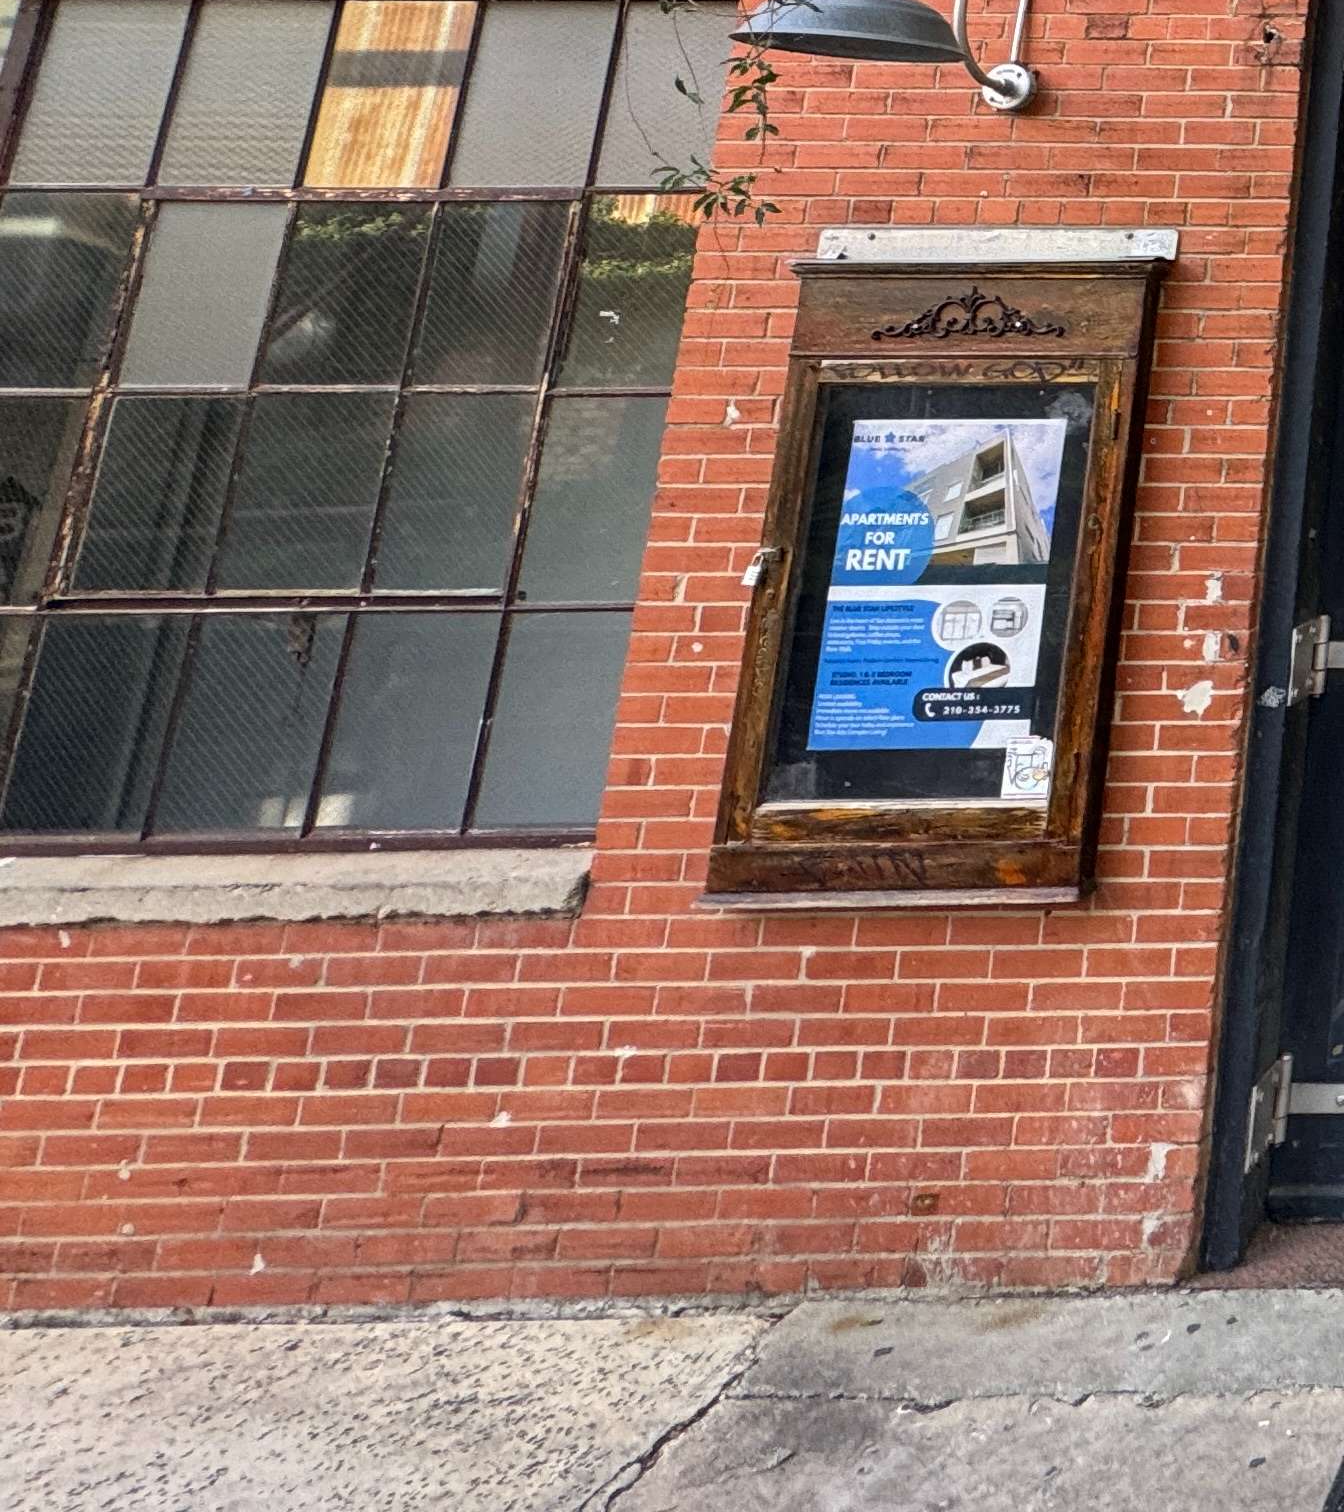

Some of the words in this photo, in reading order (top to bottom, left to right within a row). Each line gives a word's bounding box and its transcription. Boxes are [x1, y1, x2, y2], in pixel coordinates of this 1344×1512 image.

[854, 435, 881, 443] BLUE
[898, 435, 926, 443] STAR
[840, 512, 930, 526] APARTMENTS
[864, 531, 896, 545] FOR
[845, 549, 911, 571] RENT
[922, 692, 962, 701] CONTACT
[943, 705, 1020, 716] 210-354-3775
